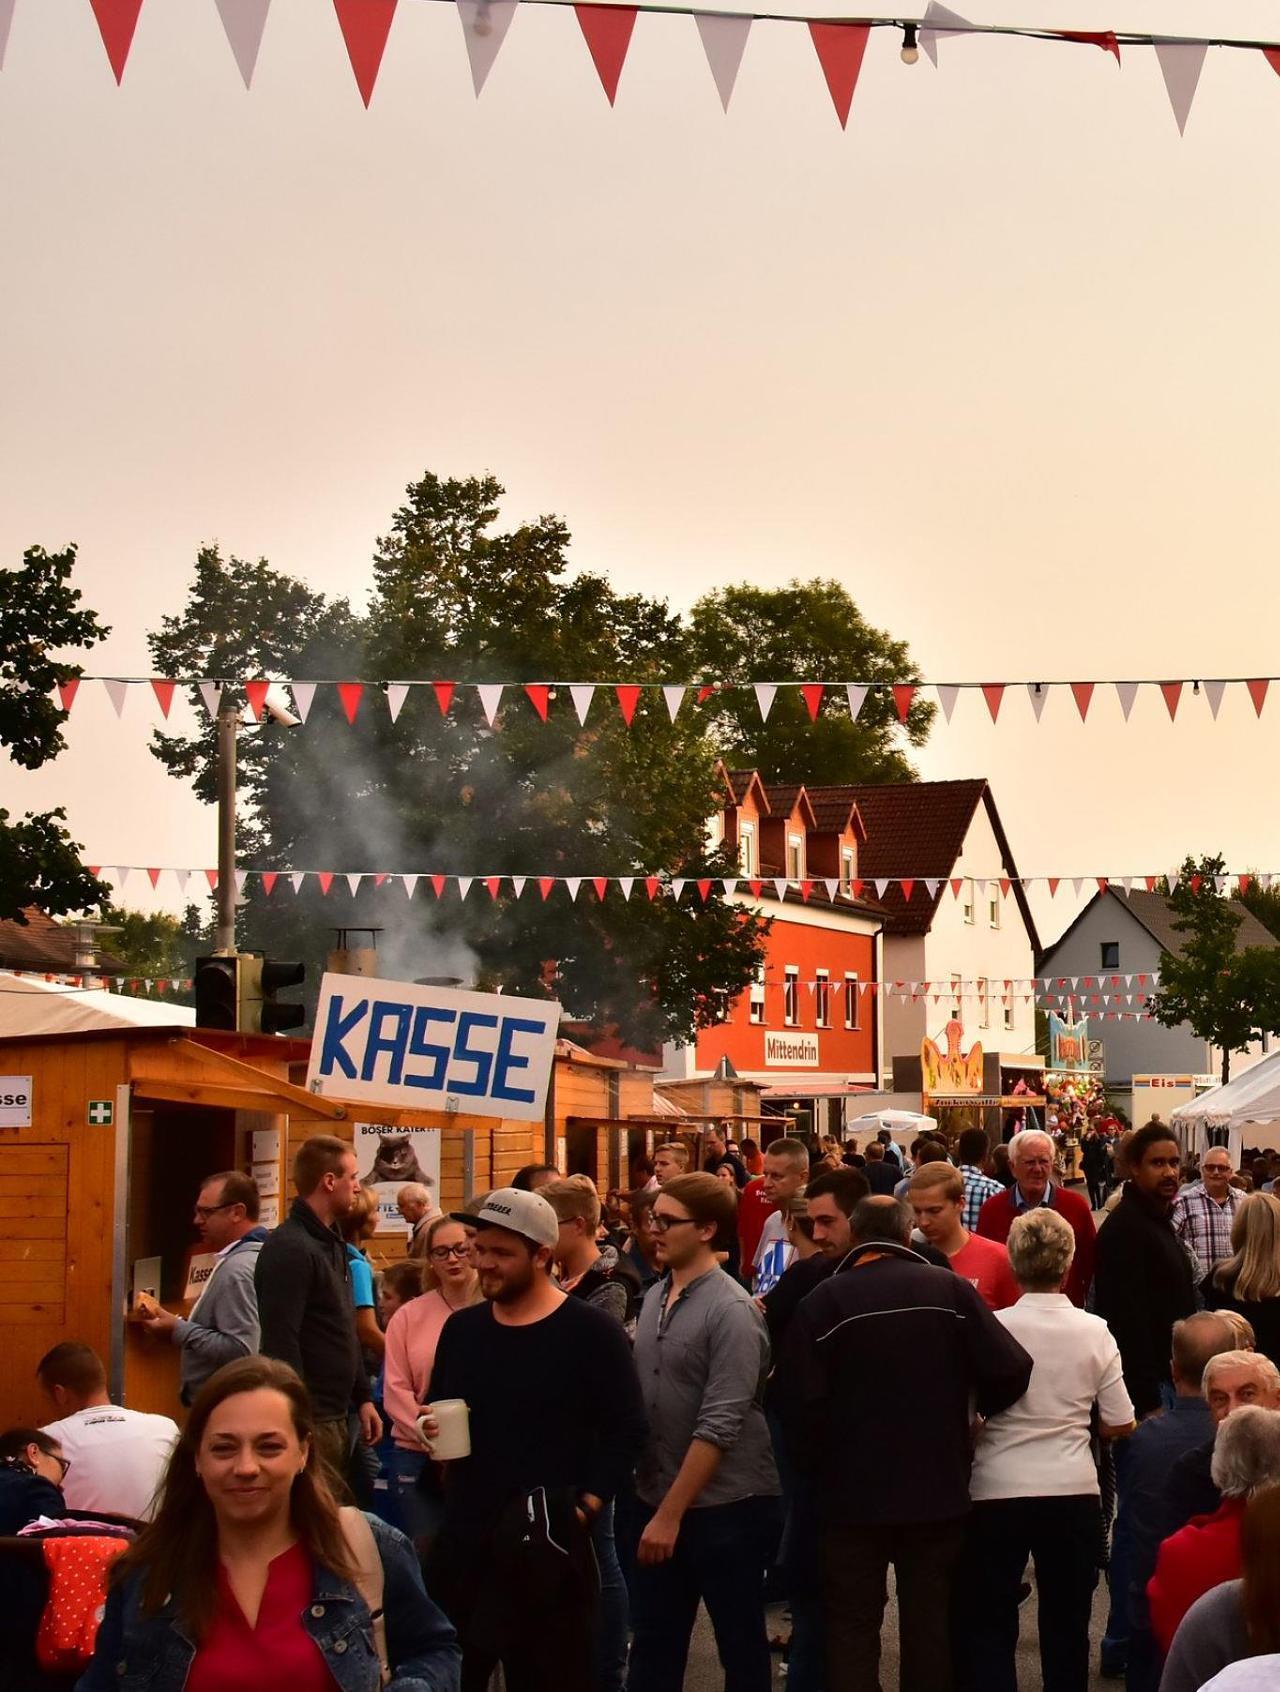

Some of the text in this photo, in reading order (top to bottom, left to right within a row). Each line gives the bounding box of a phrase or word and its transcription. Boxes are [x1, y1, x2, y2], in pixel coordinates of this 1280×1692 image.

[319, 995, 547, 1104] KASSE
[767, 1038, 817, 1060] Mittendrin
[1151, 1078, 1176, 1088] Eis
